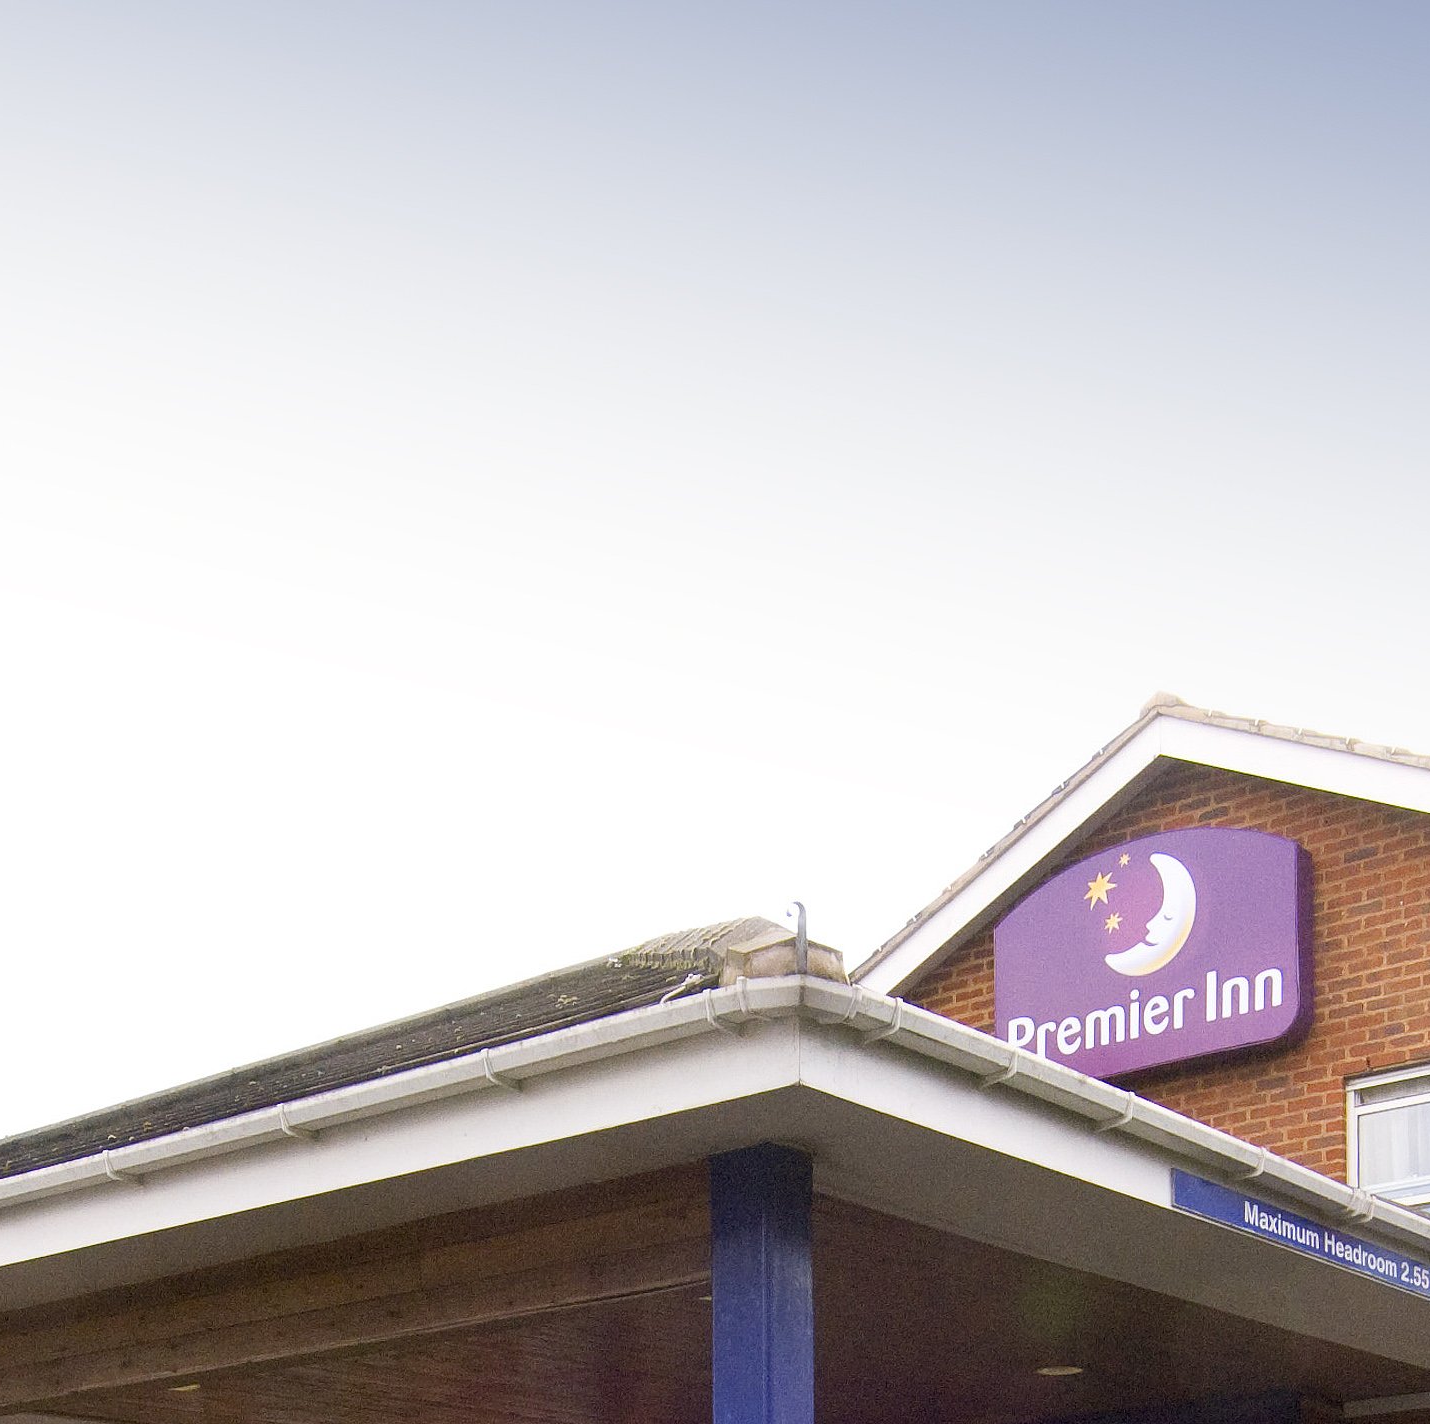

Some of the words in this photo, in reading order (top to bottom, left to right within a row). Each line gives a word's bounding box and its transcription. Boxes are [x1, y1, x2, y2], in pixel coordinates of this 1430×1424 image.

[1007, 988, 1196, 1059] Premier
[1205, 967, 1284, 1022] Inn
[1243, 1200, 1320, 1250] Maximum
[1323, 1231, 1398, 1279] Headroom
[1400, 1261, 1430, 1291] 2.55
